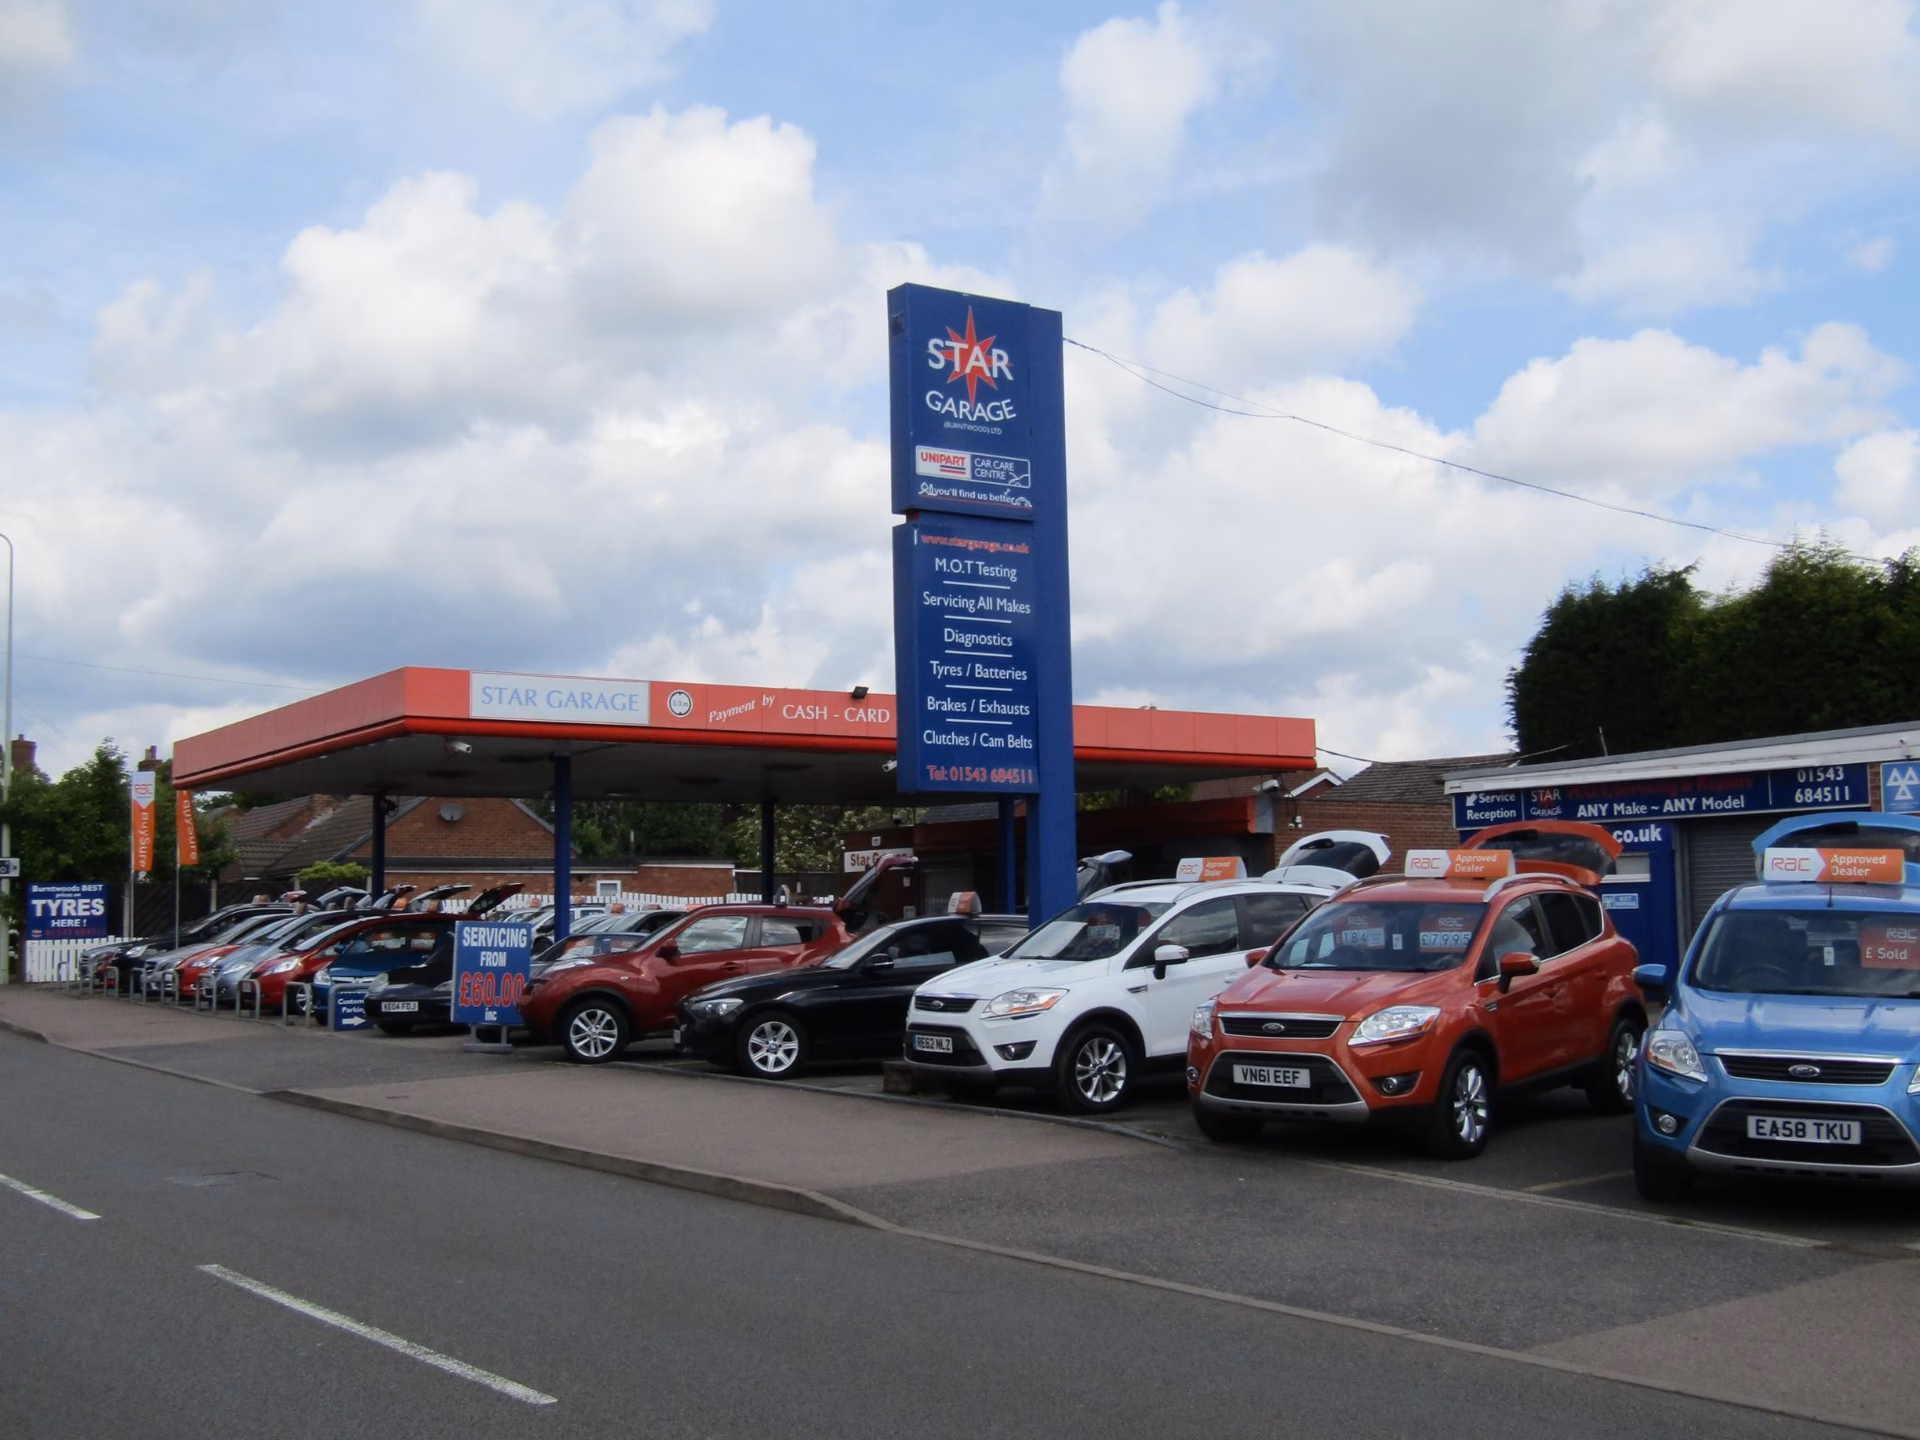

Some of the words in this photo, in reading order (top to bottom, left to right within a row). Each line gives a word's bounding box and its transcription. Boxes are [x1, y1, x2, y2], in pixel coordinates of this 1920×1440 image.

[927, 338, 1014, 381] STAR
[925, 390, 1016, 422] GARAGE
[991, 427, 1003, 435] LTD
[920, 451, 966, 467] UNIPART
[974, 457, 992, 469] CAR
[993, 460, 1014, 471] CARE
[974, 468, 1006, 480] CENTRE
[934, 486, 957, 496] you'll
[958, 489, 976, 499] find
[977, 493, 988, 501] us
[935, 557, 974, 575] M.O.T
[975, 560, 1017, 582] Testing
[923, 591, 975, 613] Servicing
[977, 597, 993, 611] All
[996, 599, 1031, 614] Makes
[944, 628, 1013, 647] Diagnostics
[930, 661, 962, 679] Tyres
[975, 663, 1028, 681] Batteries
[482, 685, 538, 707] STAR
[546, 690, 639, 712] GARAGE
[927, 696, 967, 712] Brakes
[979, 700, 1030, 716] Exhausts
[708, 700, 756, 723] Payment
[762, 694, 776, 708] by
[782, 704, 828, 721] CASH
[844, 707, 891, 723] CARD
[923, 730, 970, 747] Clutches
[979, 733, 1005, 748] Cam
[1008, 735, 1033, 749] Belts
[926, 765, 948, 781] Tel:
[949, 766, 987, 782] 01543
[1797, 765, 1845, 783] 01543
[1478, 792, 1515, 804] Service
[1530, 788, 1561, 802] STAR
[1794, 785, 1850, 803] 684511
[1529, 805, 1562, 817] GARAGE
[1577, 802, 1609, 818] ANY
[1612, 801, 1648, 816] Make
[1662, 797, 1697, 813] ANY
[1702, 794, 1745, 811] Model
[1466, 808, 1517, 821] Reception
[850, 853, 871, 867] Star
[1455, 854, 1499, 863] Approved
[1830, 853, 1887, 866] Approved
[1203, 869, 1222, 877] Dealer
[1454, 863, 1485, 873] Dealer
[1830, 866, 1871, 877] Dealer
[81, 884, 104, 892] BEST
[31, 898, 105, 917] TYRES
[51, 919, 81, 928] HERE
[462, 926, 528, 948] SERVICING
[1421, 931, 1471, 946] £7995
[480, 950, 507, 967] FROM
[1877, 947, 1907, 960] Sold
[458, 971, 525, 1008] £60.00
[484, 1007, 498, 1021] inc
[1241, 1066, 1271, 1084] VN61
[1273, 1069, 1301, 1085] EEF
[1755, 1118, 1807, 1139] EA58
[1812, 1122, 1852, 1141] TKU
